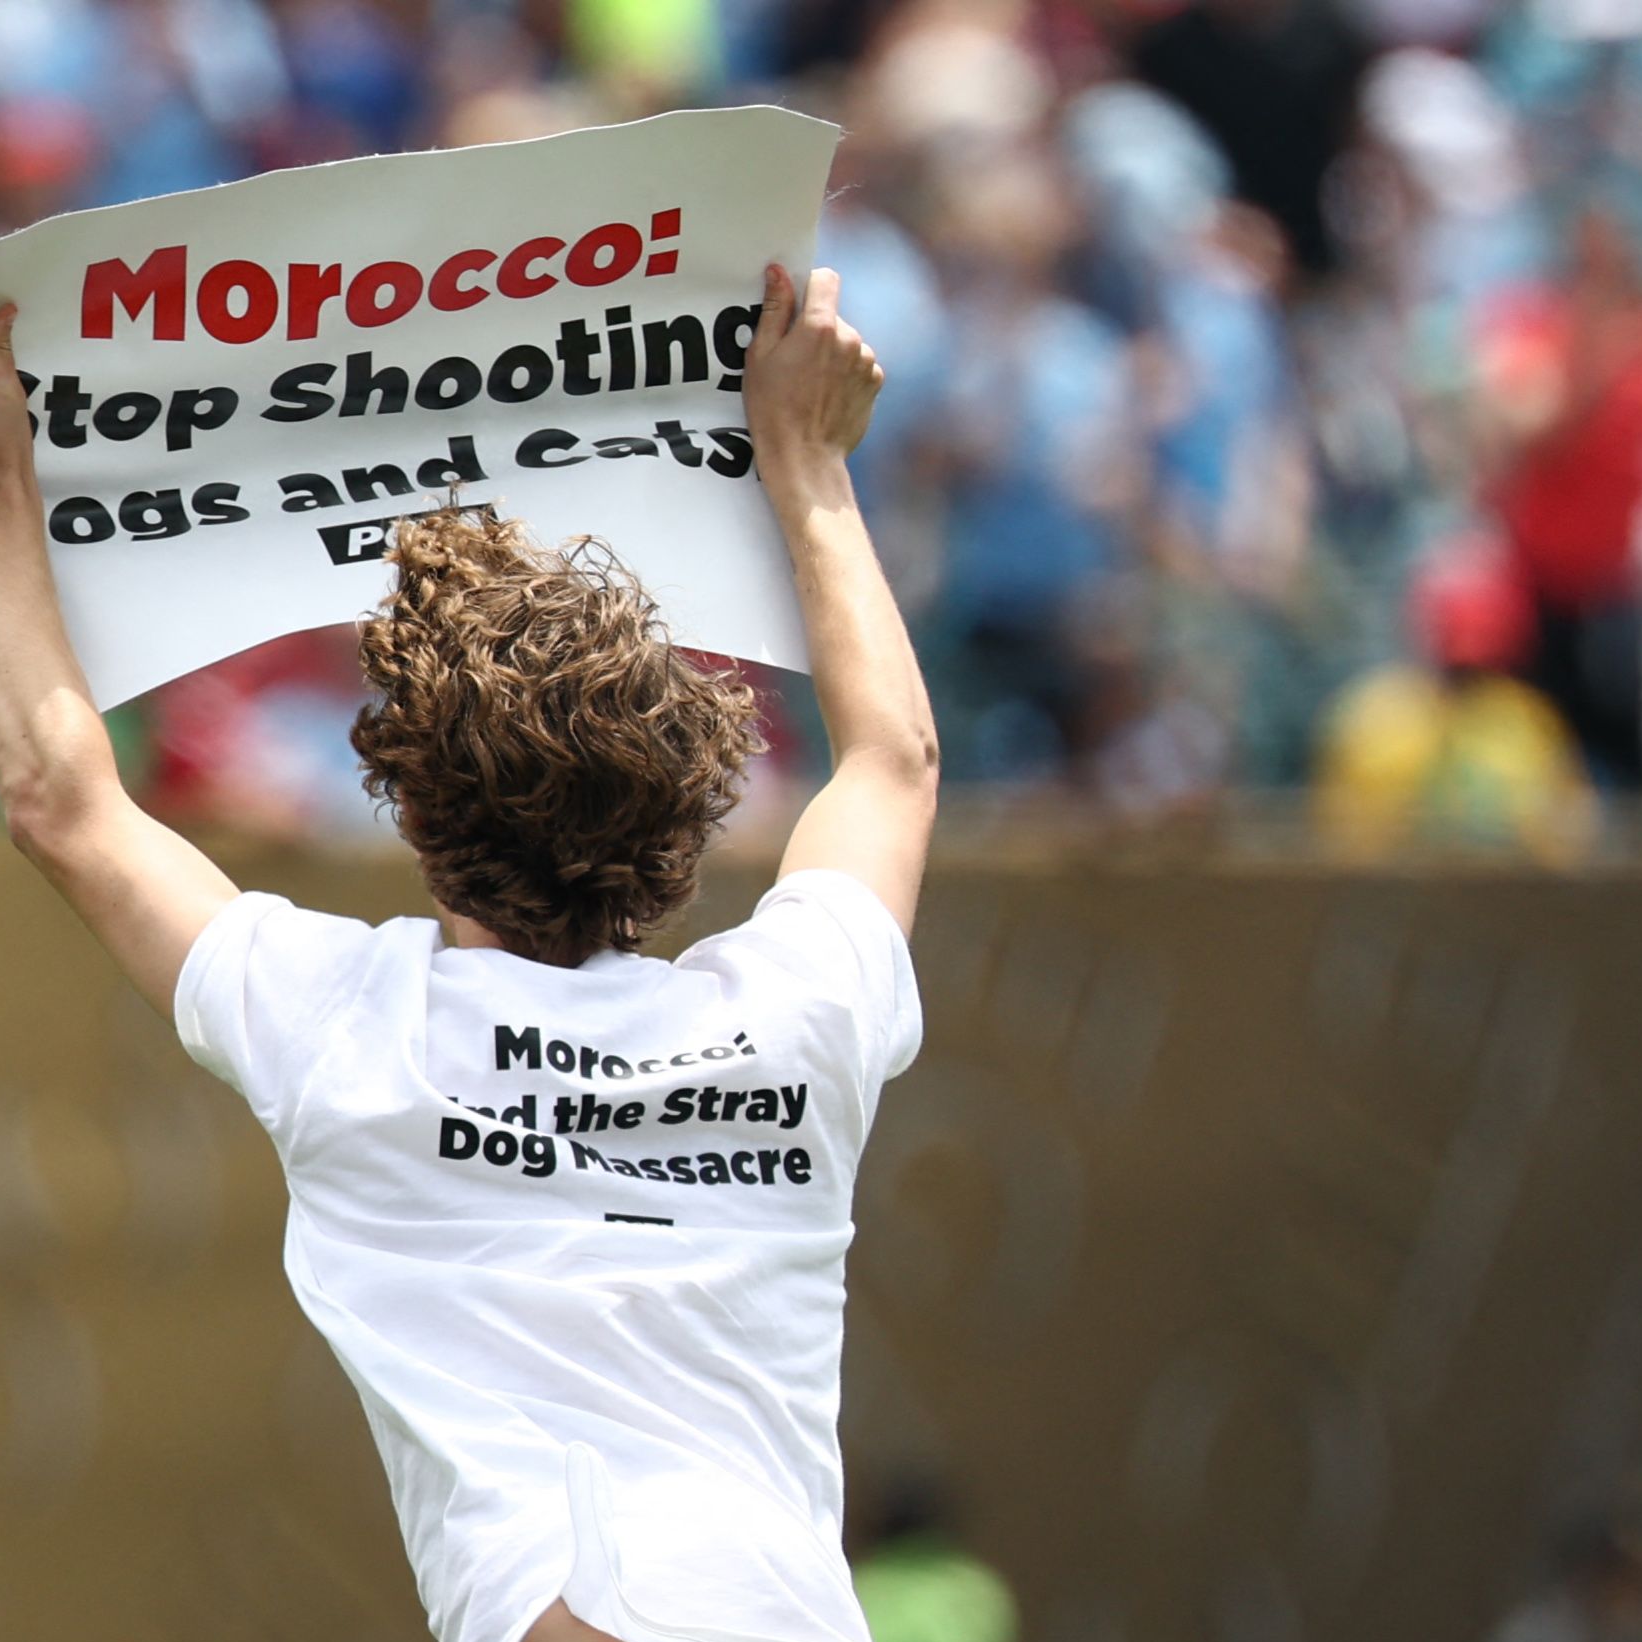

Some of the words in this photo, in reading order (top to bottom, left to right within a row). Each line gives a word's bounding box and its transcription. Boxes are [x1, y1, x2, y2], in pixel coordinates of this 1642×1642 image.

[80, 207, 683, 344] Morocco:
[259, 304, 764, 423] Shooting
[48, 481, 251, 545] ogs
[276, 435, 490, 513] and
[515, 420, 761, 481] Cats
[493, 1025, 758, 1080] Morocco:
[438, 1116, 558, 1178] Dog
[568, 1139, 813, 1186] Massacre
[553, 1093, 645, 1135] the
[657, 1083, 808, 1130] Stray
